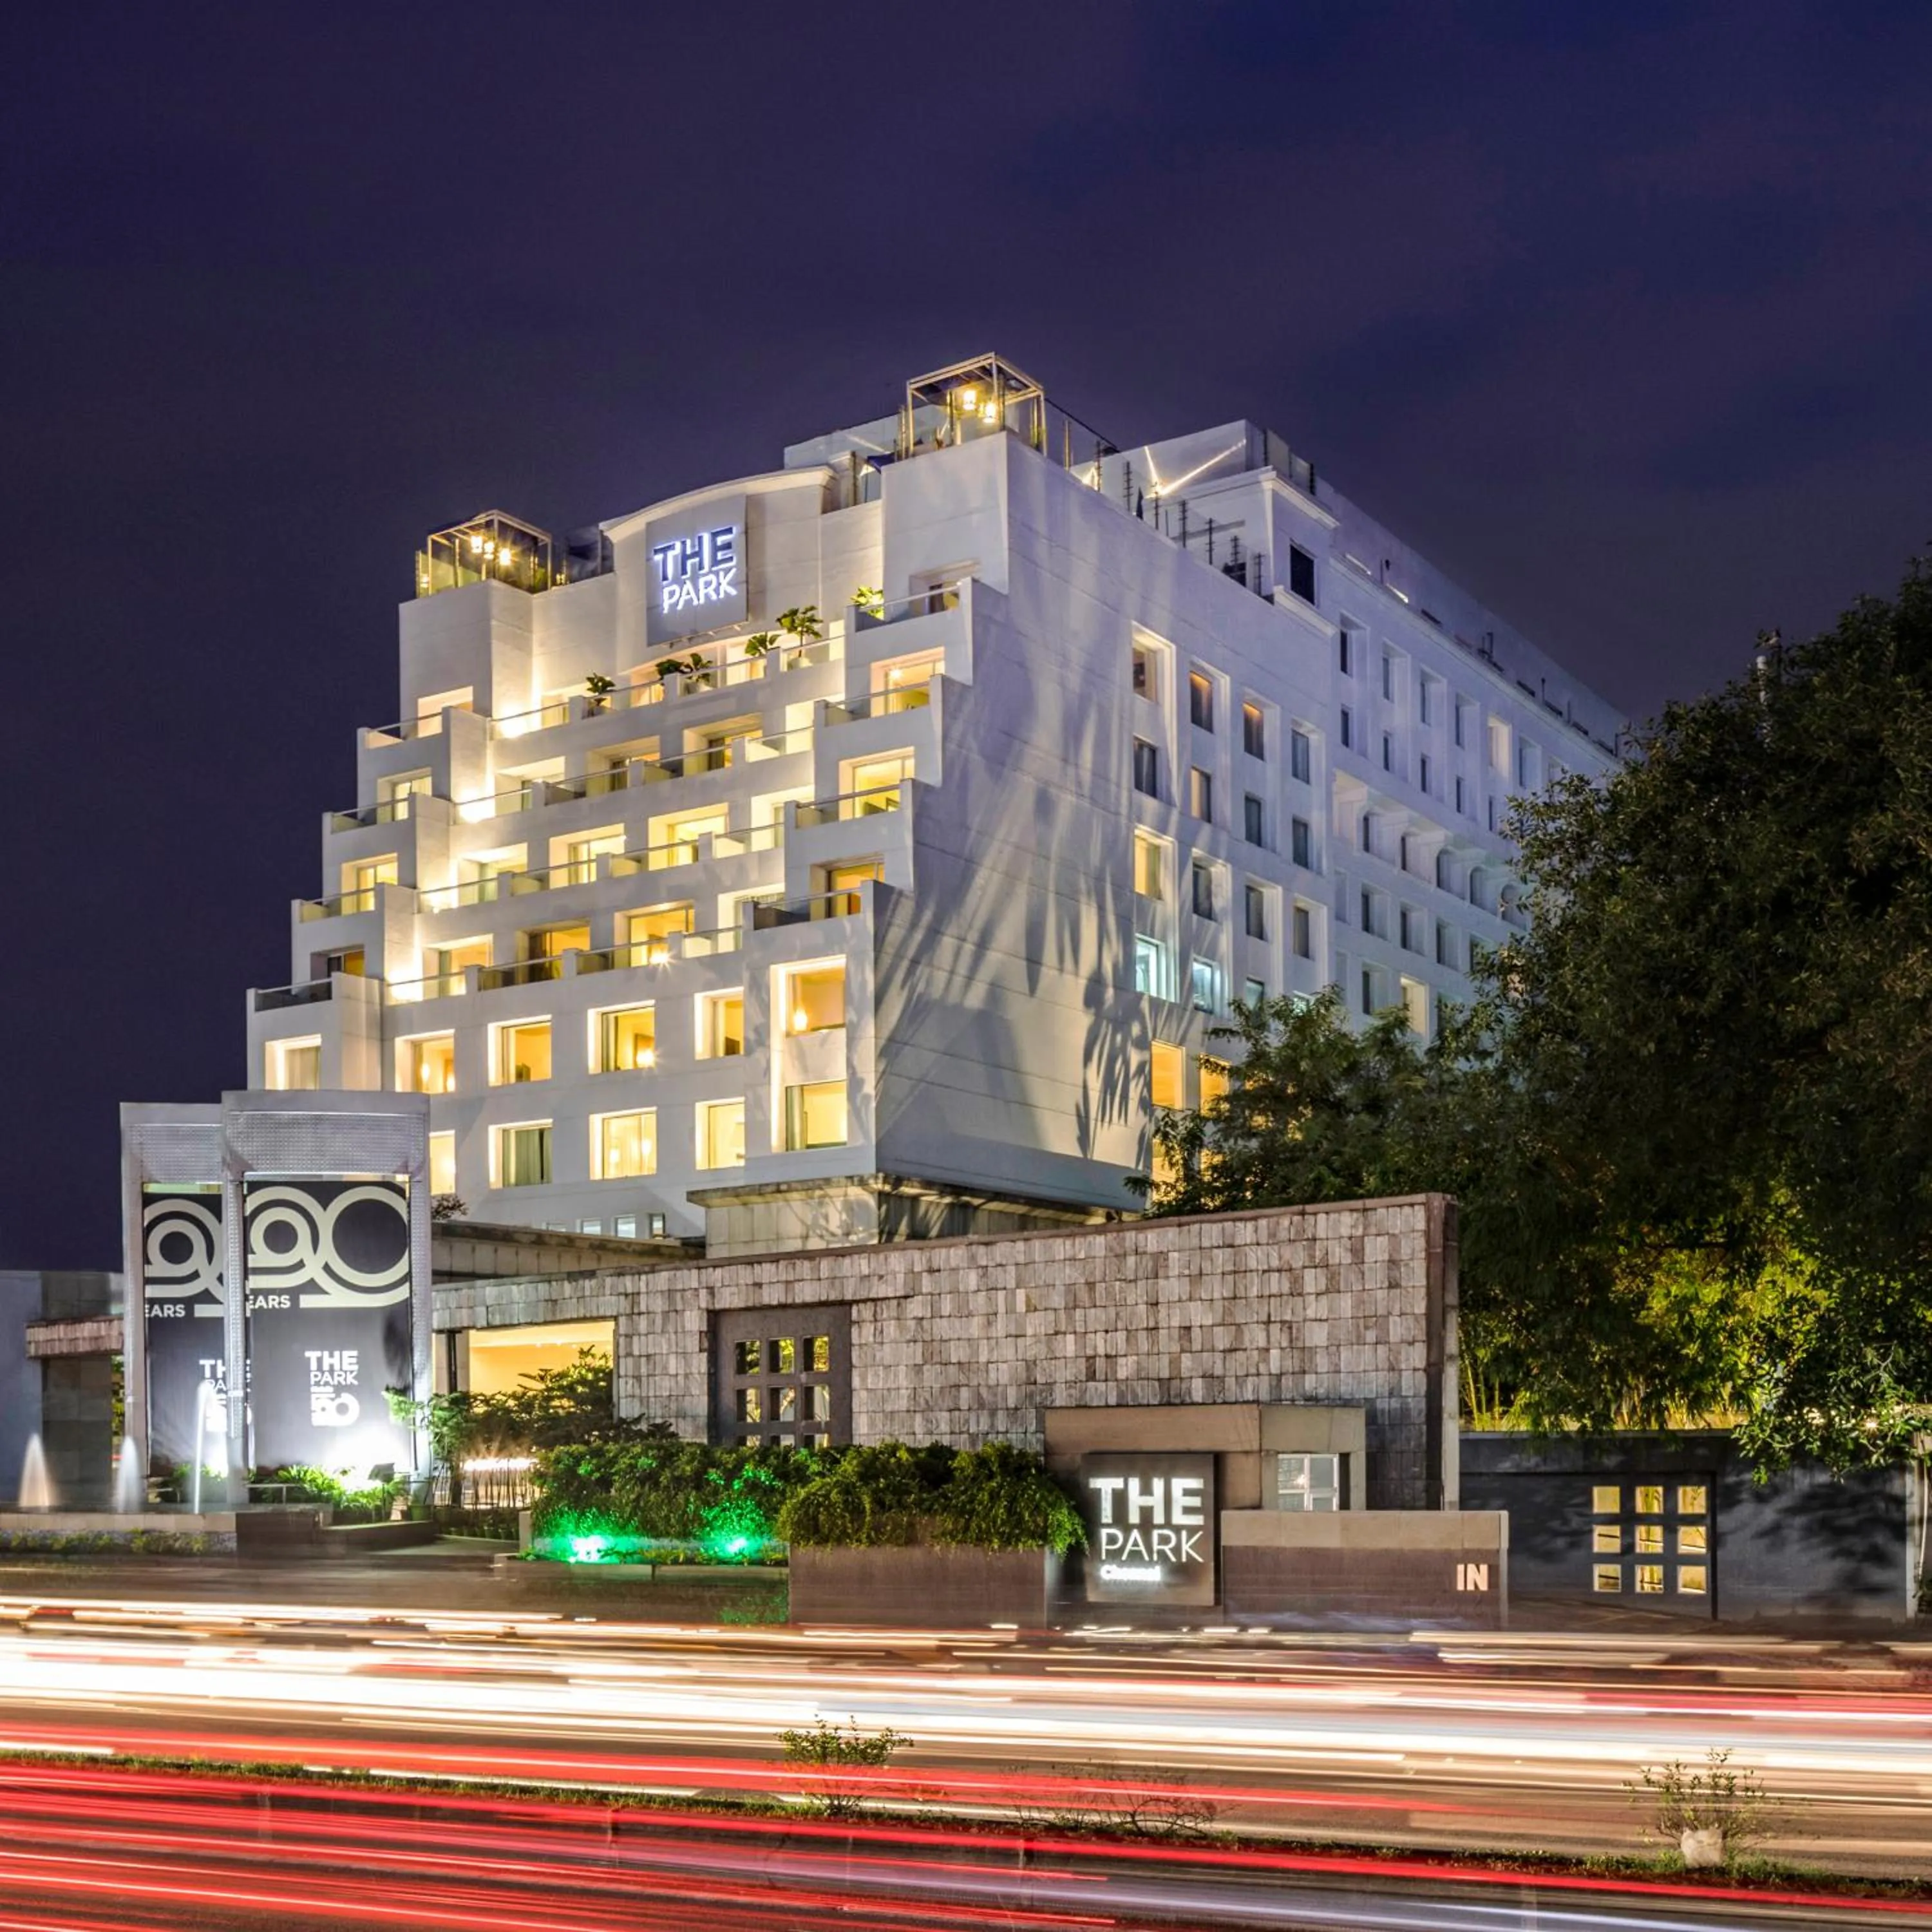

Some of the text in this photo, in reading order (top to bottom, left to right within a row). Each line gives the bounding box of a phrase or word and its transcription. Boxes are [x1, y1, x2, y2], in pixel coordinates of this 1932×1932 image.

[652, 526, 737, 583] THE
[662, 568, 737, 614] PARK
[305, 1350, 359, 1371] THE
[310, 1371, 359, 1385] PARK
[1088, 1477, 1204, 1525] THE
[1101, 1528, 1204, 1562] PARK
[1457, 1564, 1488, 1591] IN
